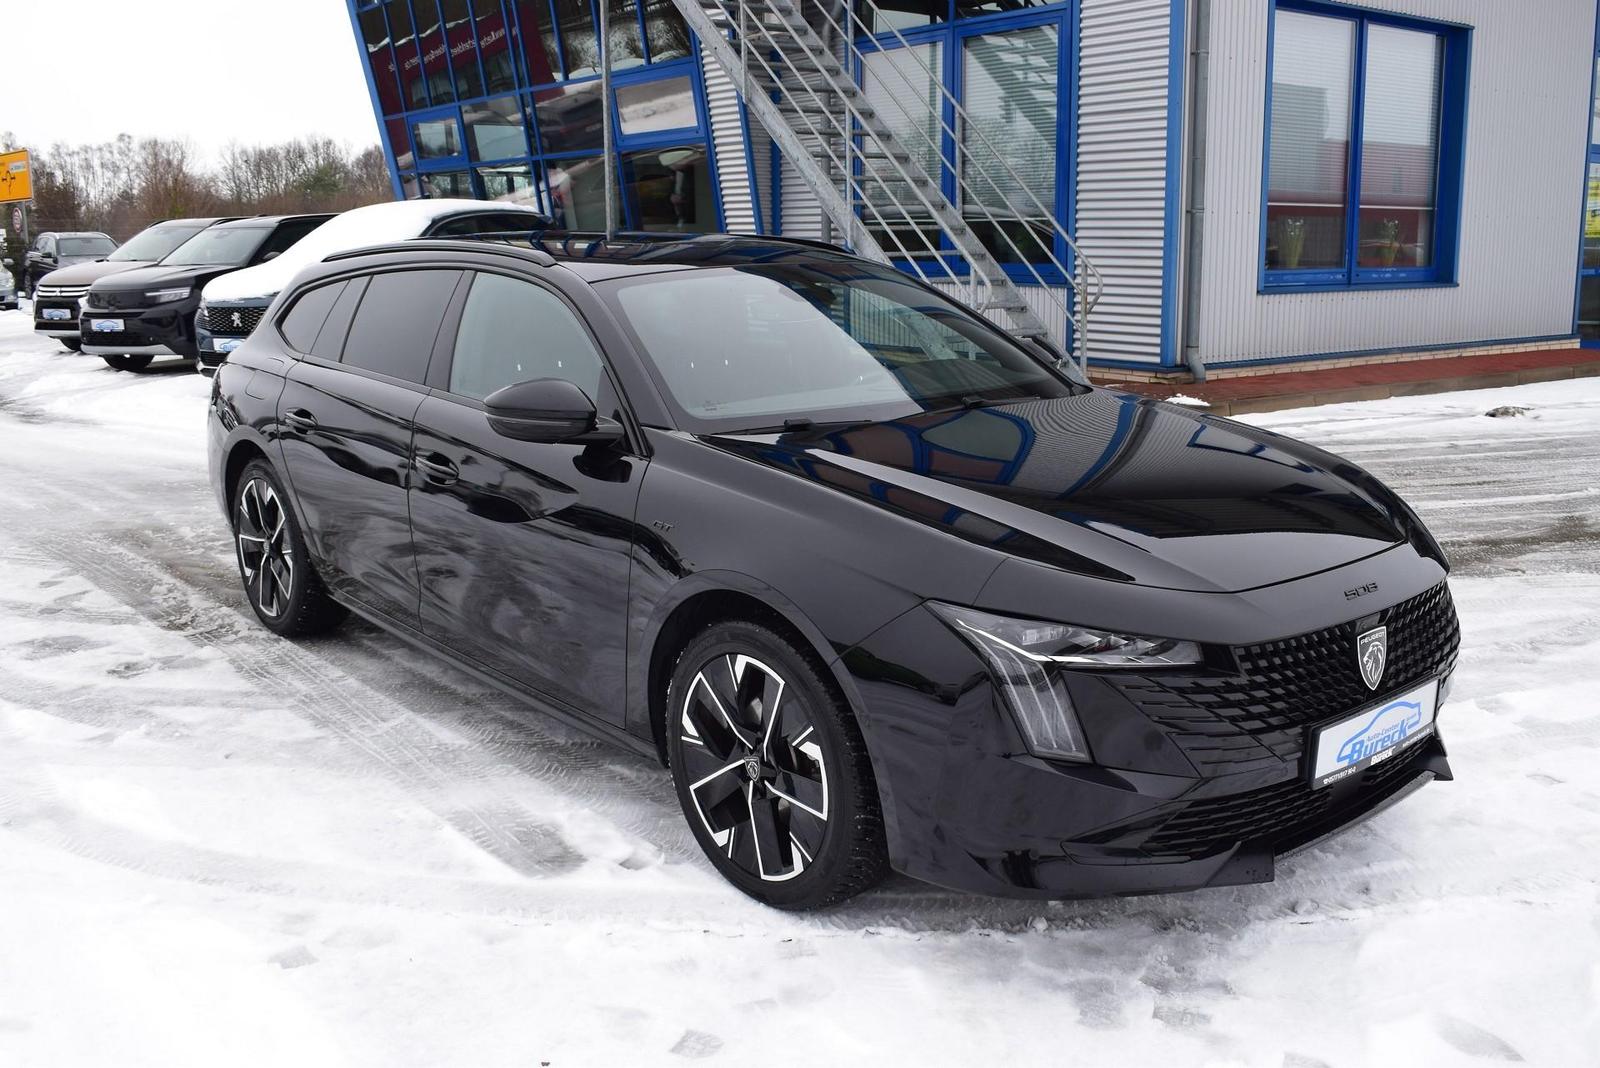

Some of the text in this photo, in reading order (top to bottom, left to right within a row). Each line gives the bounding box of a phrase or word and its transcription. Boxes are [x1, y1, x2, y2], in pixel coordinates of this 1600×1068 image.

[1344, 582, 1379, 601] 508
[1360, 631, 1385, 646] PEUGEOT
[1347, 719, 1409, 766] Bureck
